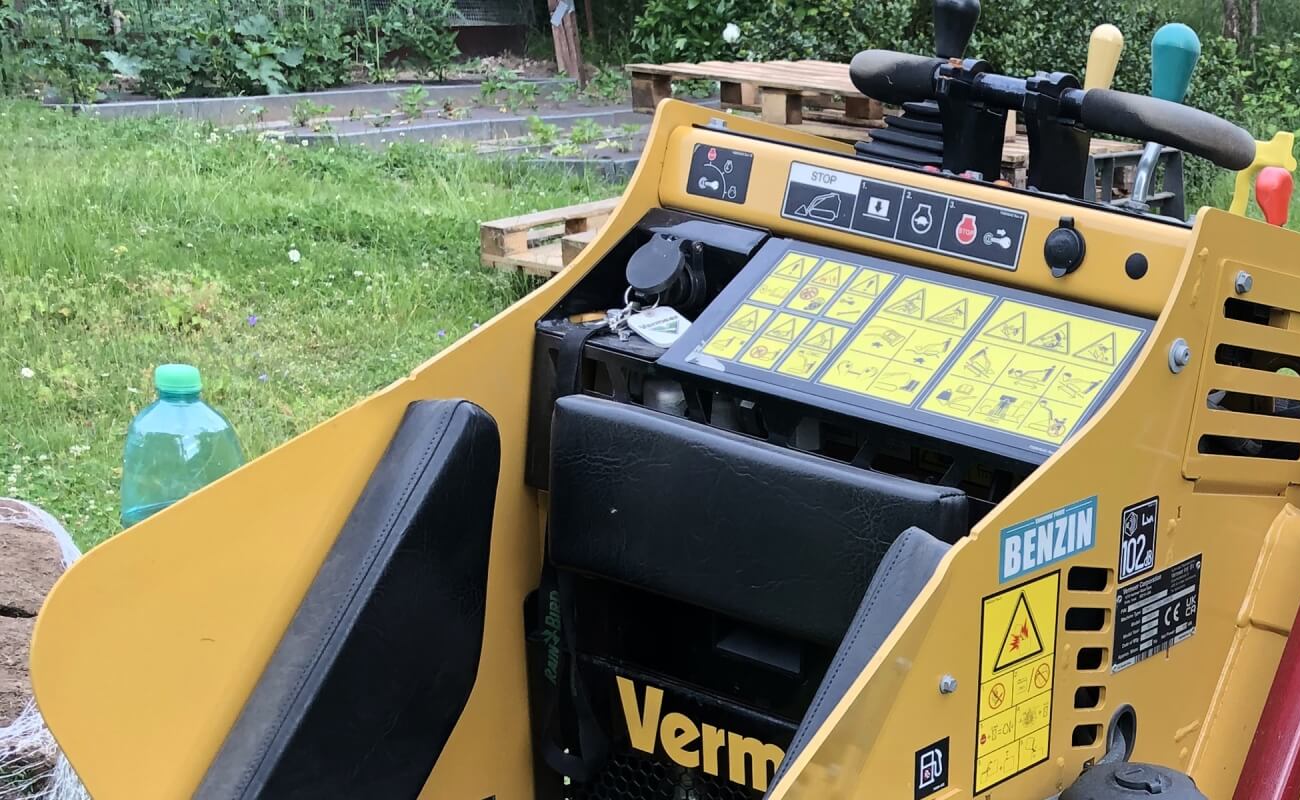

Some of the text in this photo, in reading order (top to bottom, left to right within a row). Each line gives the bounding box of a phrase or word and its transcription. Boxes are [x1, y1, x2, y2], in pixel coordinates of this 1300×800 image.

[810, 170, 837, 185] STOP
[862, 181, 868, 190] 1.
[906, 191, 913, 200] 2.
[950, 200, 956, 209] 3.
[958, 227, 975, 236] STOP
[1004, 507, 1093, 578] BENZIN
[1123, 534, 1146, 577] 102
[1165, 602, 1180, 626] CE
[544, 645, 559, 686] RAIN
[616, 676, 785, 792] Verm
